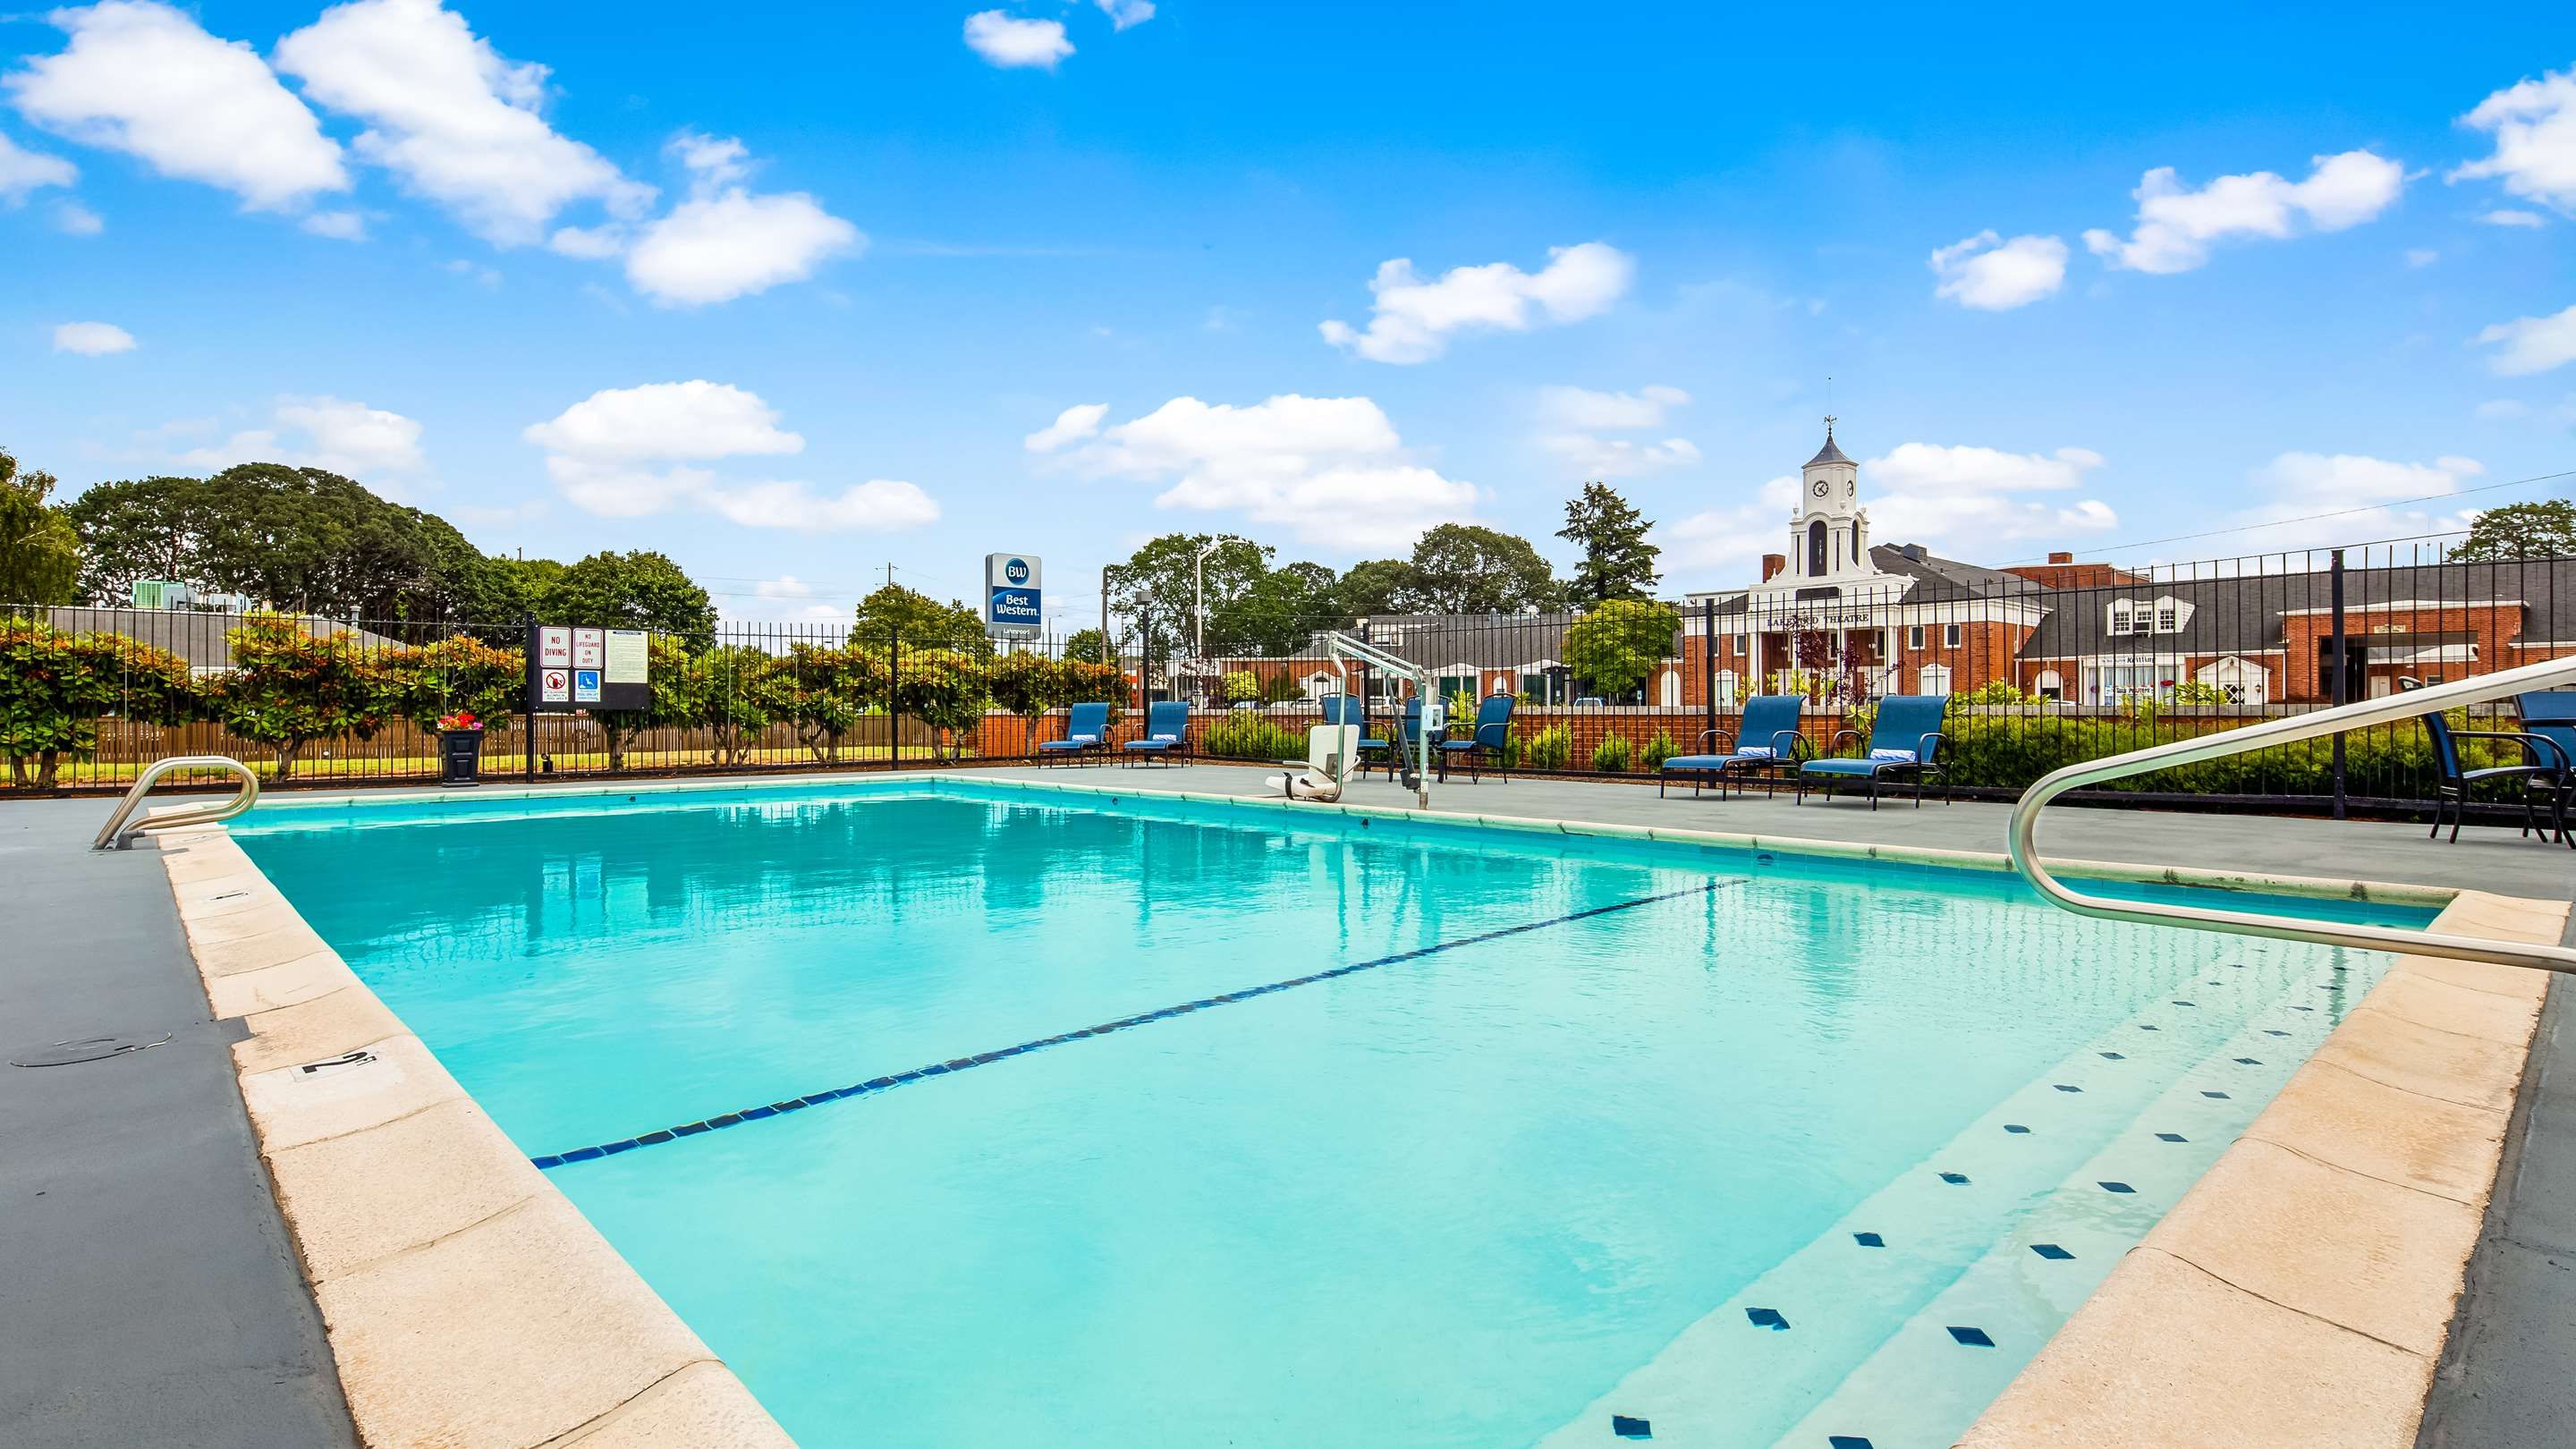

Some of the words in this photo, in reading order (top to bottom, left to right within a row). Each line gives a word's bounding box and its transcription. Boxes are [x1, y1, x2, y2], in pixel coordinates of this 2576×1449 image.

[1008, 565, 1027, 578] BW
[1005, 594, 1029, 606] Best
[551, 636, 561, 644] NO
